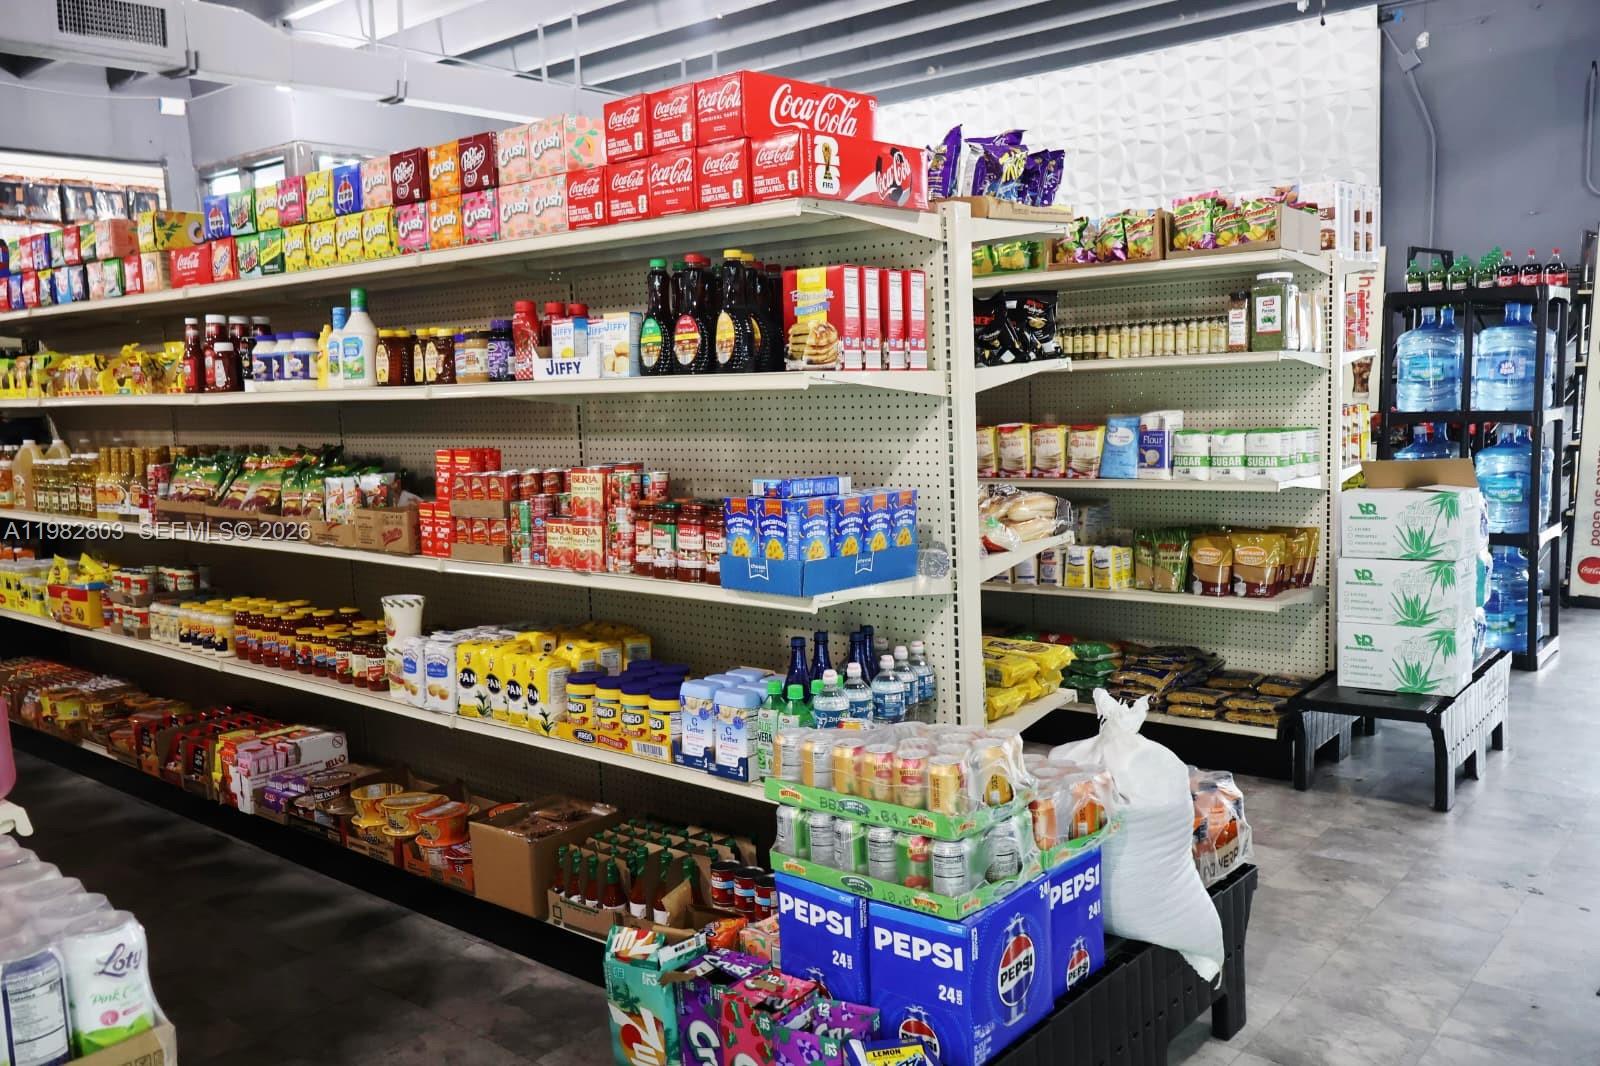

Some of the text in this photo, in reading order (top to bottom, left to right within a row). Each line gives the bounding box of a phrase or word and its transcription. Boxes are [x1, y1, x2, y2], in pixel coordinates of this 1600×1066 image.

[608, 106, 641, 129] Coca-Cola
[653, 96, 689, 120] Coca-Cola
[770, 84, 861, 136] Coca-Cola
[499, 140, 527, 167] Crush
[531, 131, 561, 159] Crush
[430, 157, 456, 180] Crush
[702, 151, 741, 176] Coca-Cola
[363, 172, 387, 194] Crush
[568, 177, 600, 199] Coca-Cola
[611, 168, 645, 192] Coca-Cola
[822, 181, 834, 190] FIFA
[277, 188, 299, 209] Crush
[307, 185, 327, 204] Crush
[532, 190, 564, 216] Crush
[463, 205, 492, 228] Crush
[501, 196, 530, 222] Crush
[364, 220, 387, 242] Crush
[399, 216, 424, 237] Crush
[431, 211, 457, 232] Crush
[312, 233, 333, 253] Crush
[337, 227, 359, 247] Crush
[553, 327, 573, 337] JIFFY
[604, 322, 628, 332] JIFFY
[546, 359, 582, 375] JIFFY
[1143, 435, 1164, 445] Flour
[1211, 456, 1242, 467] SUGAR
[1247, 456, 1278, 467] SUGAR
[1049, 862, 1101, 911] PEPSI
[779, 891, 852, 939] PEPSI
[832, 950, 847, 967] 24
[873, 926, 964, 972] PEPSI
[767, 974, 780, 983] 12
[1000, 954, 1033, 988] PEPSI
[1068, 962, 1089, 983] PEPSI
[938, 985, 956, 1002] 24
[817, 1003, 831, 1013] 12
[872, 1048, 902, 1058] LEMON
